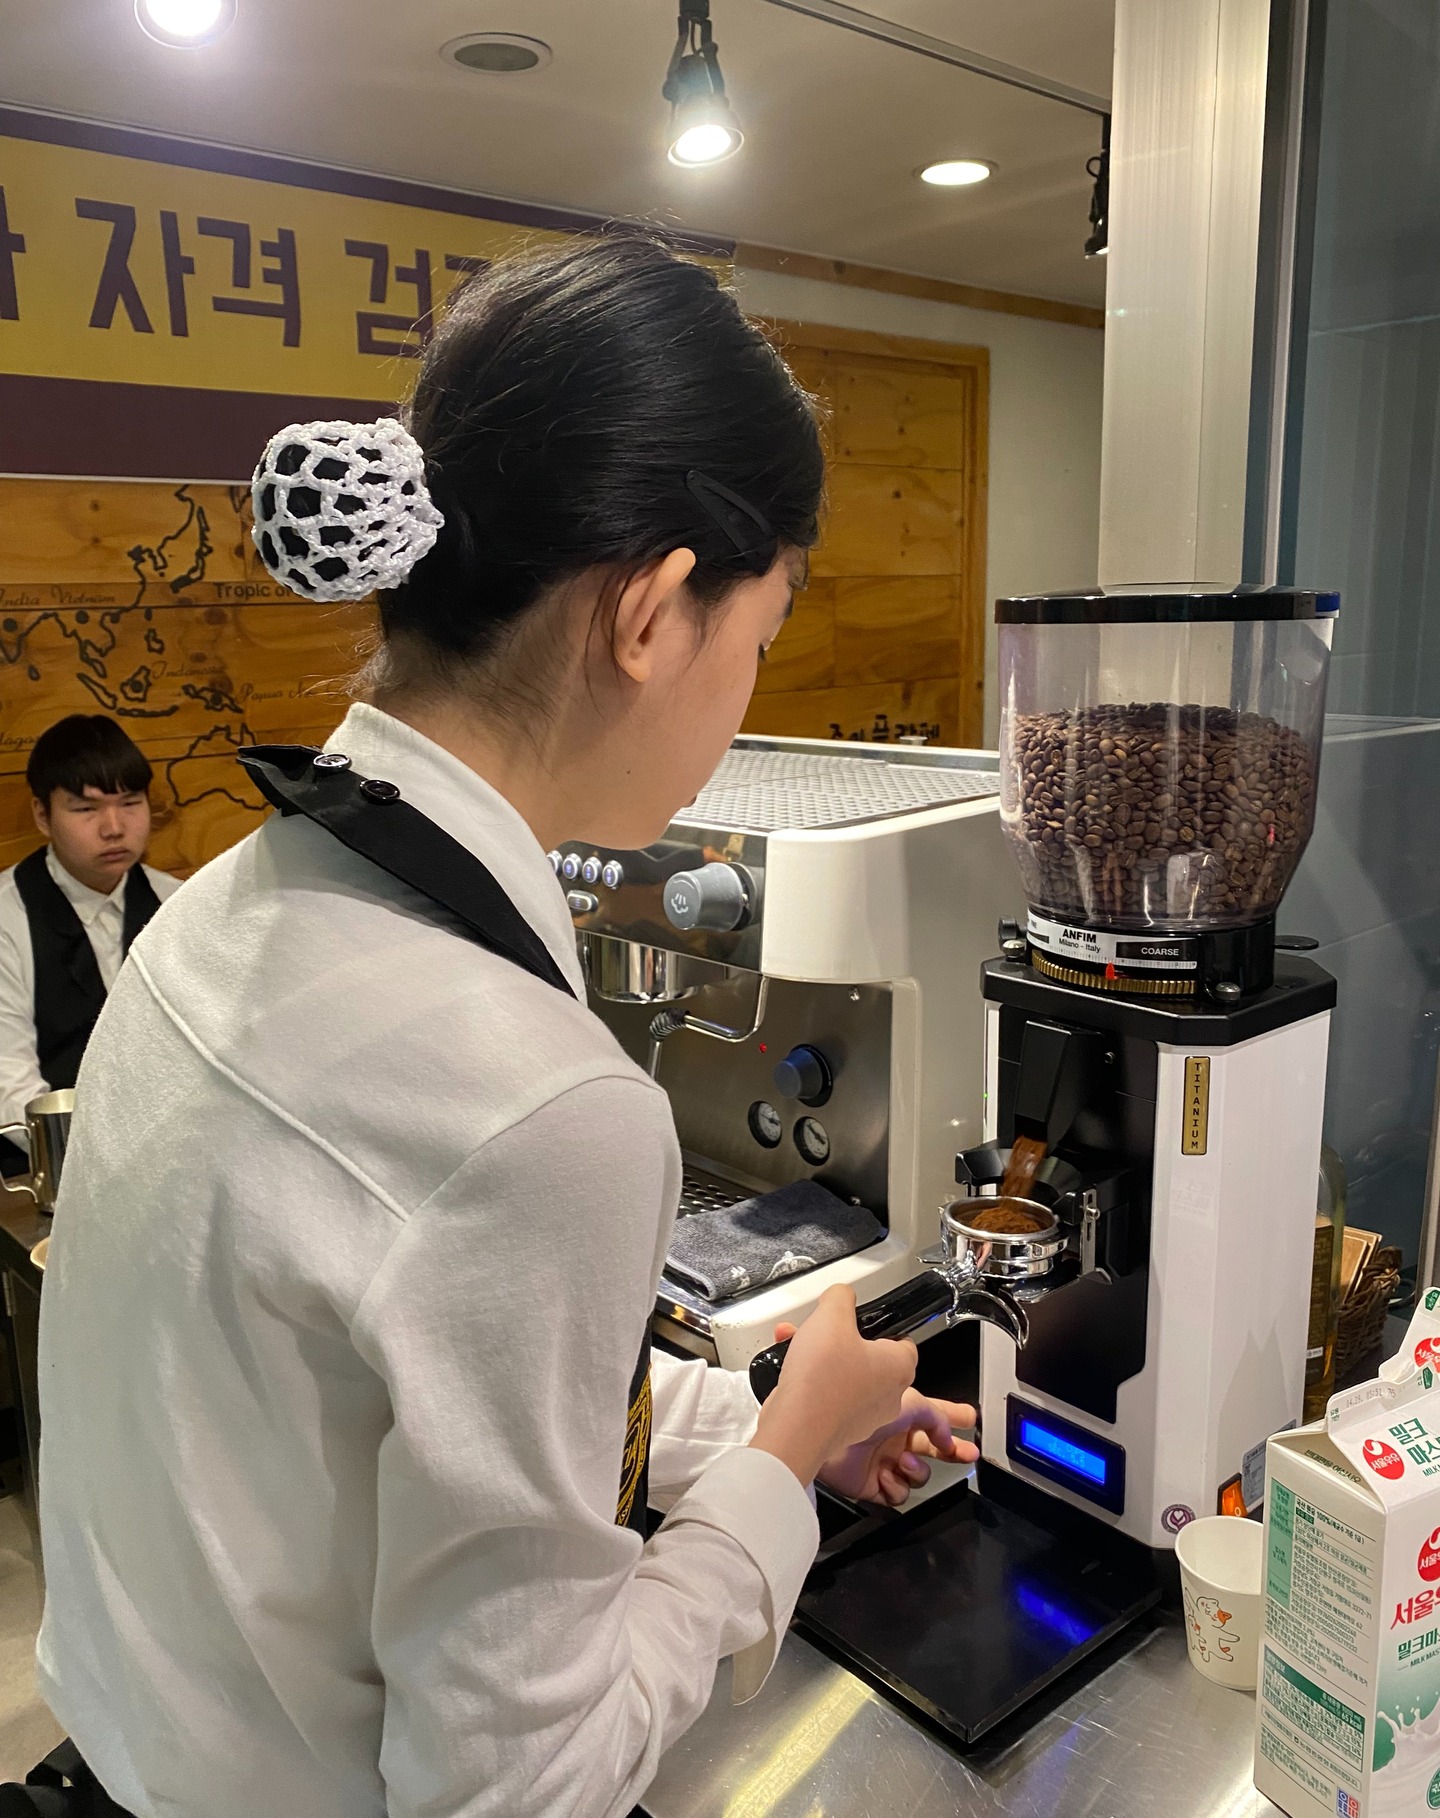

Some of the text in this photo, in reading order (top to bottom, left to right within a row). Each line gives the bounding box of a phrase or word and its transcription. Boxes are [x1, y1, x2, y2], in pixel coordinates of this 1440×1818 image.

[75, 197, 302, 348] 자격
[213, 582, 270, 600] Tropic
[1062, 928, 1097, 944] ANFIM
[1059, 938, 1080, 949] Milano
[1085, 944, 1101, 953] Italy
[1141, 947, 1179, 956] COARSE
[1190, 1062, 1201, 1149] TITANIUM
[1388, 1418, 1428, 1445] 밀크
[1406, 1437, 1440, 1466] 마스
[1371, 1453, 1400, 1471] 서울우유
[1422, 1465, 1438, 1477] MILK
[1398, 1628, 1440, 1661] 밀크마
[1410, 1654, 1426, 1667] MILK
